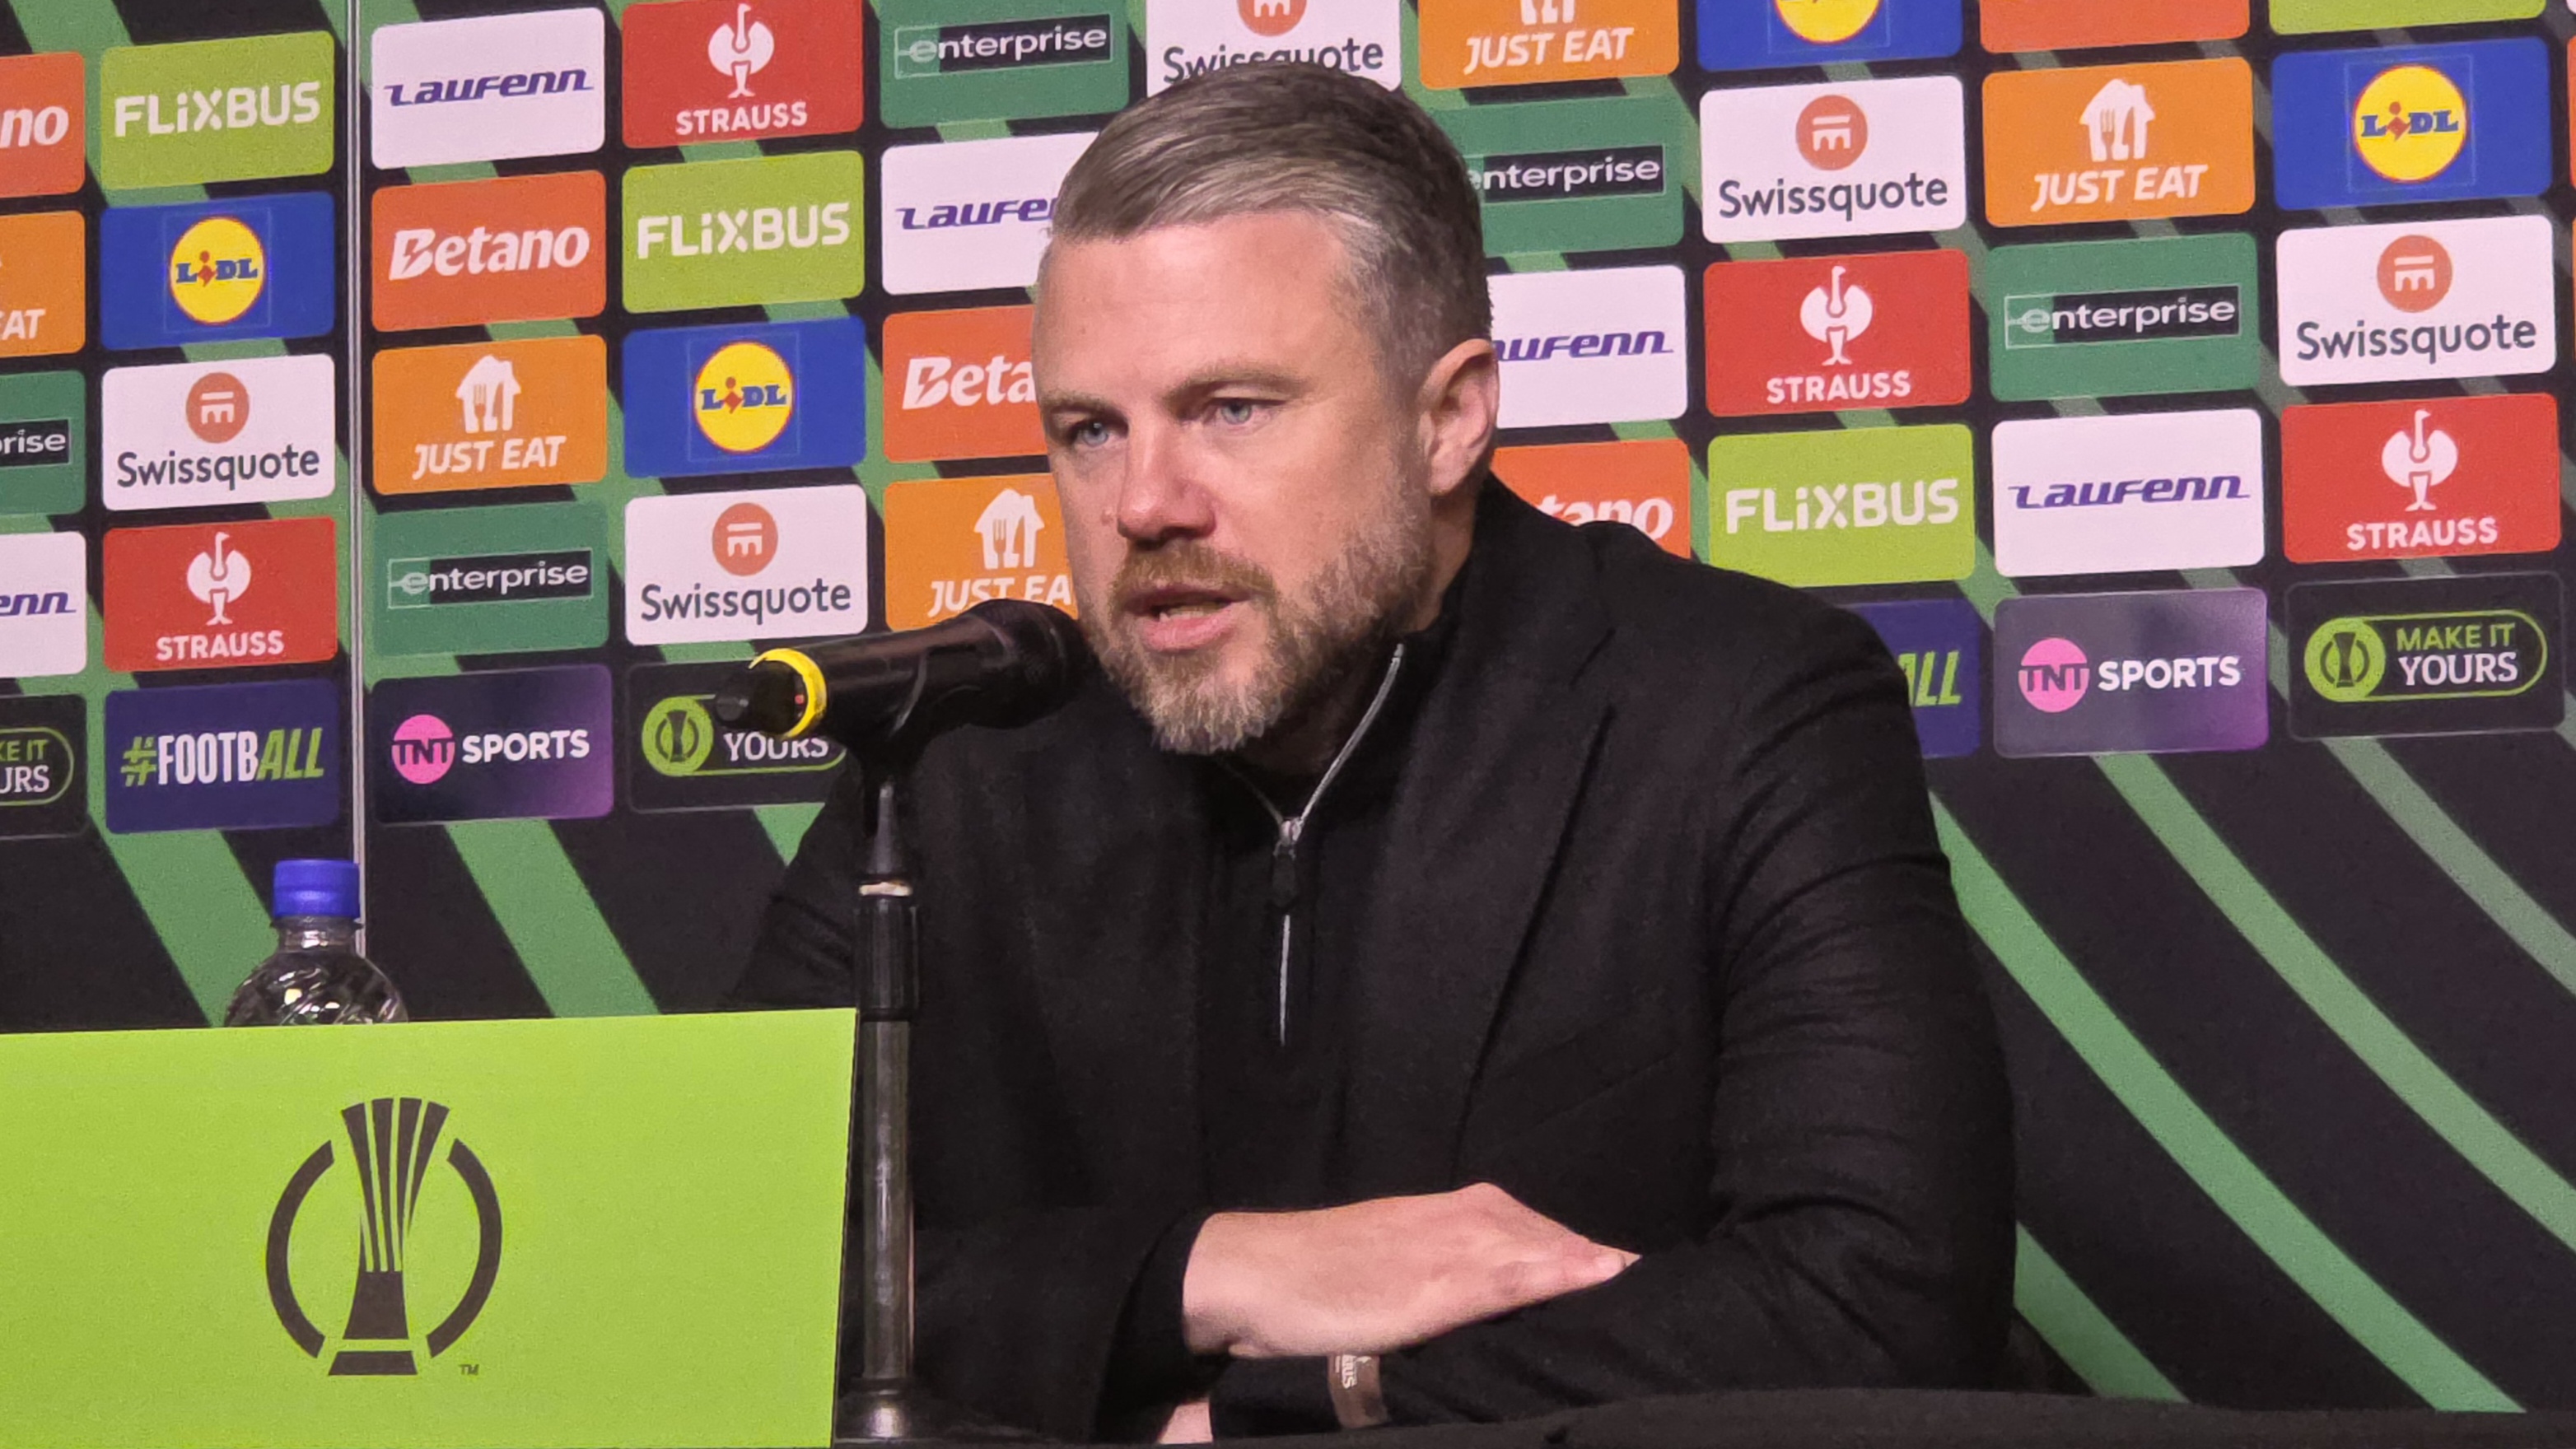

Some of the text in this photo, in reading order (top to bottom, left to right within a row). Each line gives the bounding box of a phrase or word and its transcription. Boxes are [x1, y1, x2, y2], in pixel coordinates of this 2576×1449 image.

[909, 26, 1107, 62] enterprise
[1464, 27, 1634, 75] JUST EAT
[675, 101, 808, 135] STRAUSS
[1720, 173, 1948, 221] Swissquote
[2031, 164, 2209, 212] JUST EAT
[388, 226, 590, 281] Betano
[0, 309, 46, 341] AT
[2020, 297, 2236, 333] enterprise
[2297, 314, 2537, 365] Swissquote
[1766, 371, 1911, 404] STRAUSS
[0, 429, 67, 454] rise
[413, 436, 566, 479] JUST EAT
[117, 444, 320, 491] Swissquote
[2346, 516, 2498, 550] STRAUSS
[403, 561, 589, 595] enterprise
[641, 578, 852, 624] Swissquote
[156, 631, 284, 661] STRAUSS
[2396, 622, 2516, 651] MAKE IT
[2018, 656, 2241, 692] TNT SPORTS
[2399, 651, 2518, 686] YOURS
[26, 739, 49, 761] IT
[121, 727, 325, 786] #FOOTBALL
[392, 729, 590, 766] TNT SPORTS
[459, 1363, 480, 1376] TM
